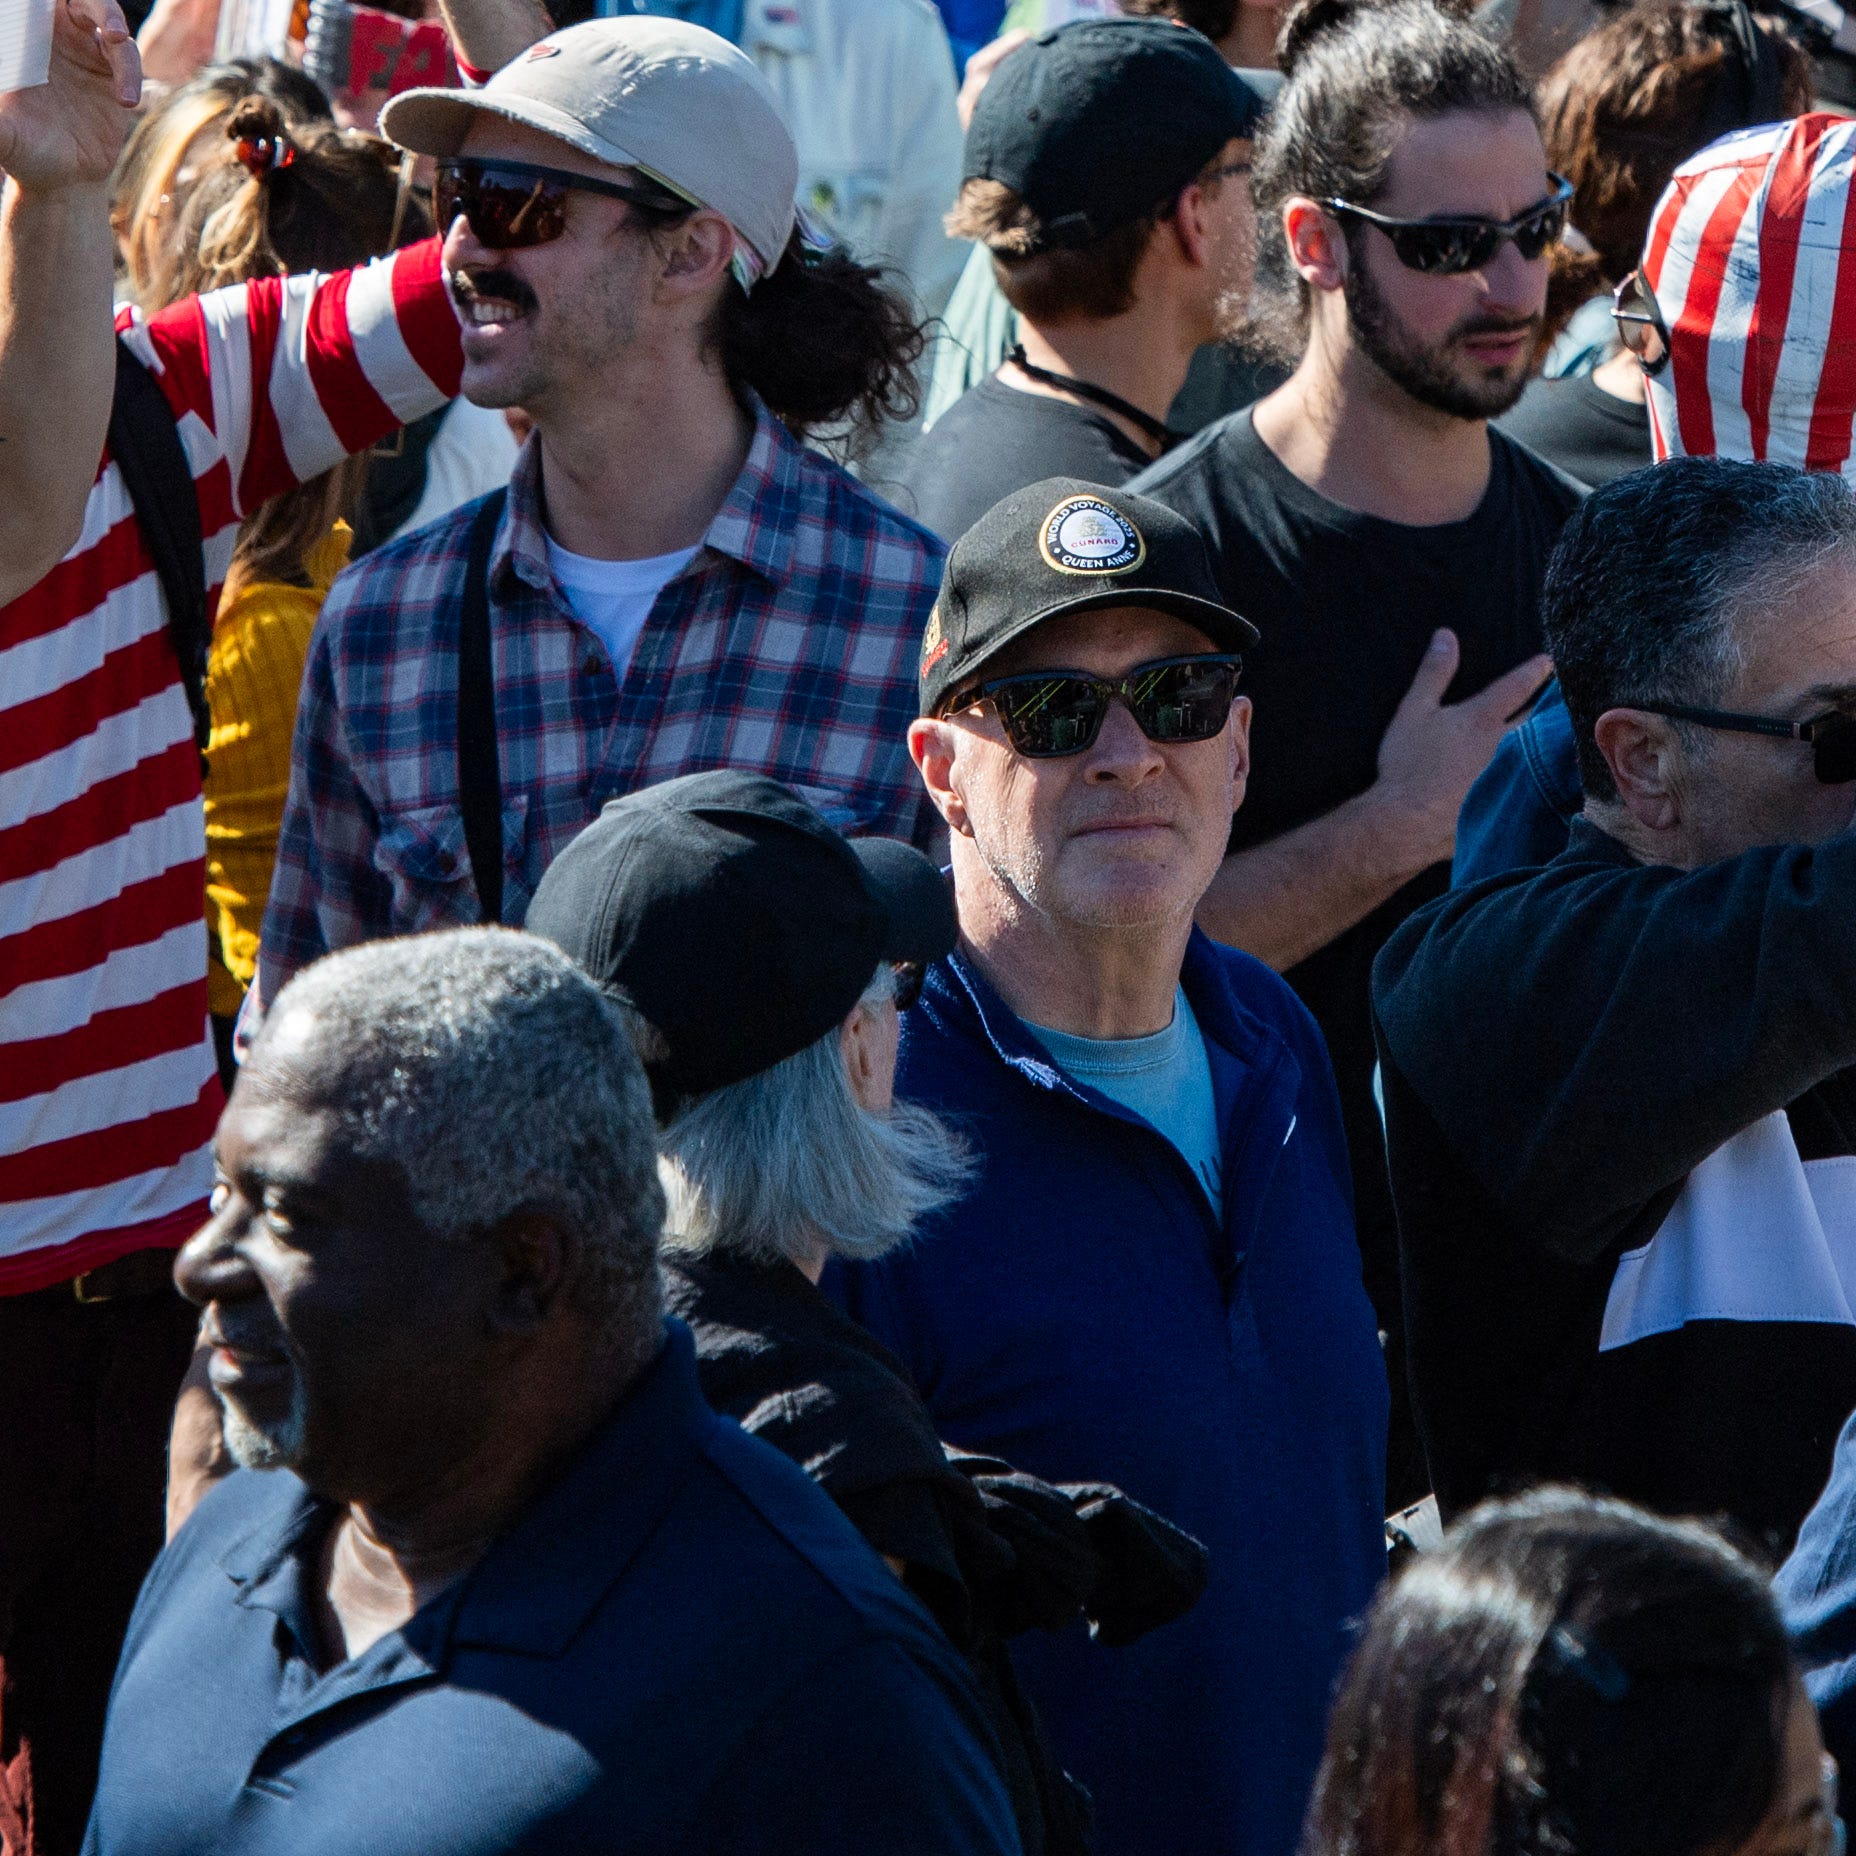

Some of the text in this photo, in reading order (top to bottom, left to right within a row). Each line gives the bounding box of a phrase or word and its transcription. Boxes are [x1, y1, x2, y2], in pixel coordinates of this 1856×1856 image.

[1047, 508, 1070, 544] WORLD
[1069, 500, 1115, 519] VOYAGE
[1070, 538, 1118, 549] CUNARD
[1061, 549, 1135, 568] QUEEN ANNE
